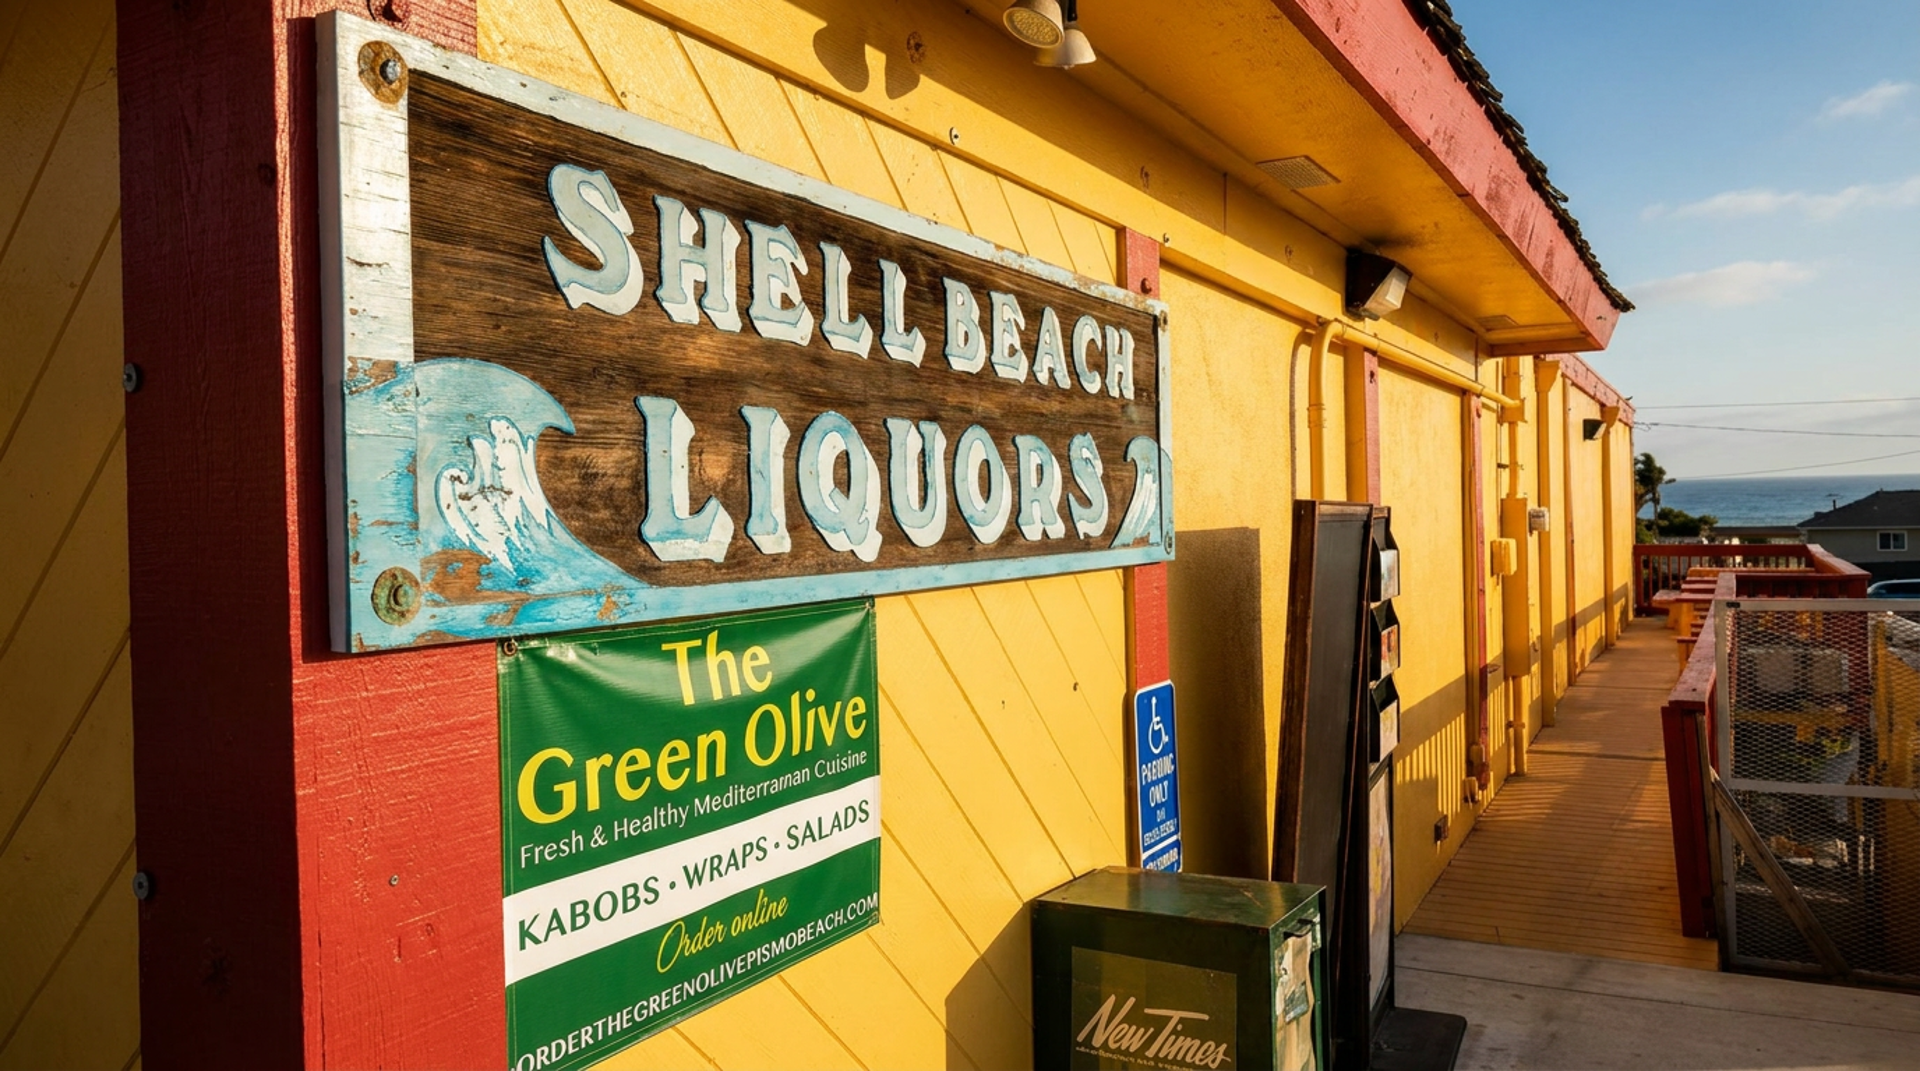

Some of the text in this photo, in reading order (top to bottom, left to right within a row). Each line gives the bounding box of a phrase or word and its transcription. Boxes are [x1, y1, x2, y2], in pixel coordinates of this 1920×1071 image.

[543, 163, 1135, 400] SHELL BEACH
[635, 395, 1108, 562] LIQUORS
[661, 631, 773, 706] The
[517, 688, 867, 824] Green Olive
[520, 825, 584, 868] Fresh
[590, 825, 608, 848] &
[613, 801, 690, 840] Healthy
[814, 750, 868, 778] Cuisine
[518, 799, 870, 951] KABOBS WRAPS SALADS
[656, 888, 788, 973] Order online
[1076, 994, 1151, 1050] New
[1143, 1007, 1232, 1069] Times
